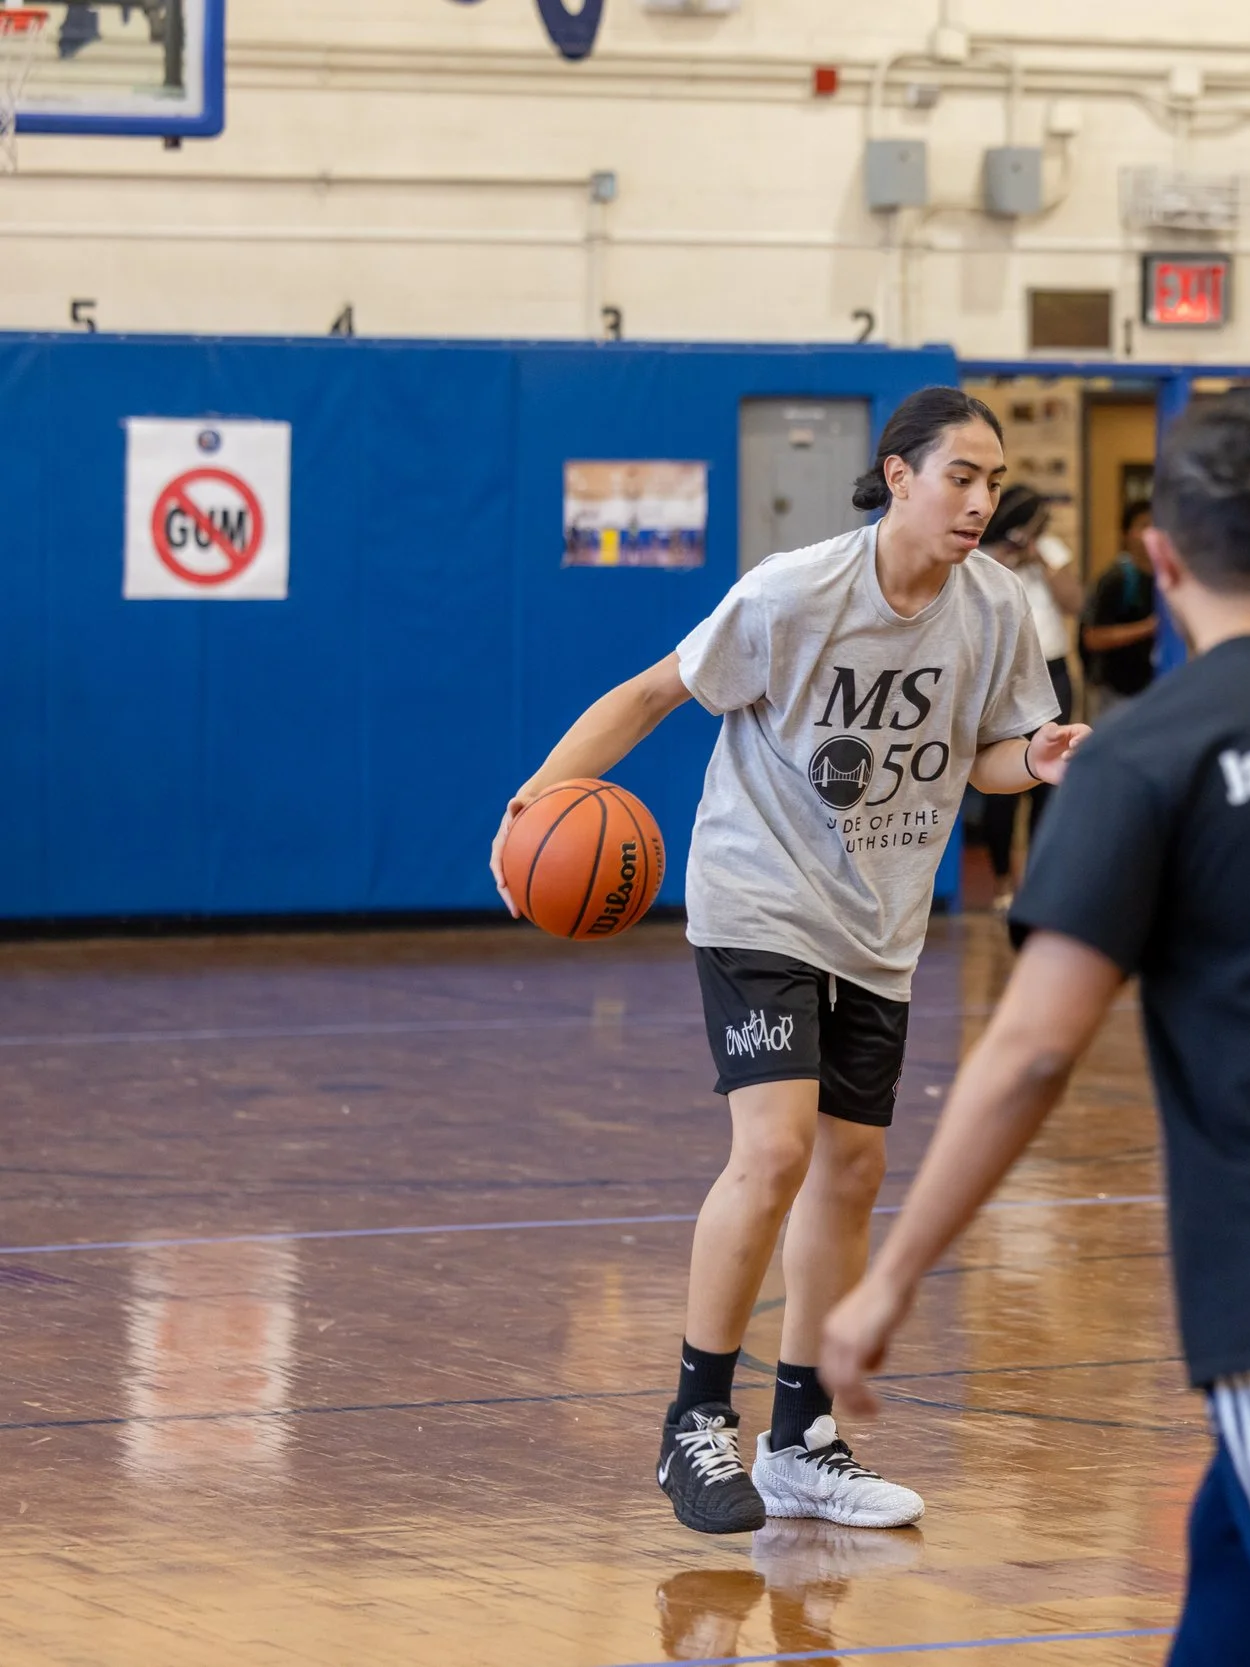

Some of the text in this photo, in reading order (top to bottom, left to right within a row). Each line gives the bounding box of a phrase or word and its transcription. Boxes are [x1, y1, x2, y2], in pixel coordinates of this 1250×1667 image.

[1155, 263, 1224, 322] EXIT
[71, 299, 96, 333] 5
[601, 306, 622, 340] 3
[165, 507, 246, 552] GUM
[814, 666, 942, 730] MS
[865, 741, 949, 806] 50
[846, 832, 928, 853] UTHSIDE
[870, 814, 893, 830] OF
[903, 810, 938, 826] THE
[586, 841, 637, 934] Wilson
